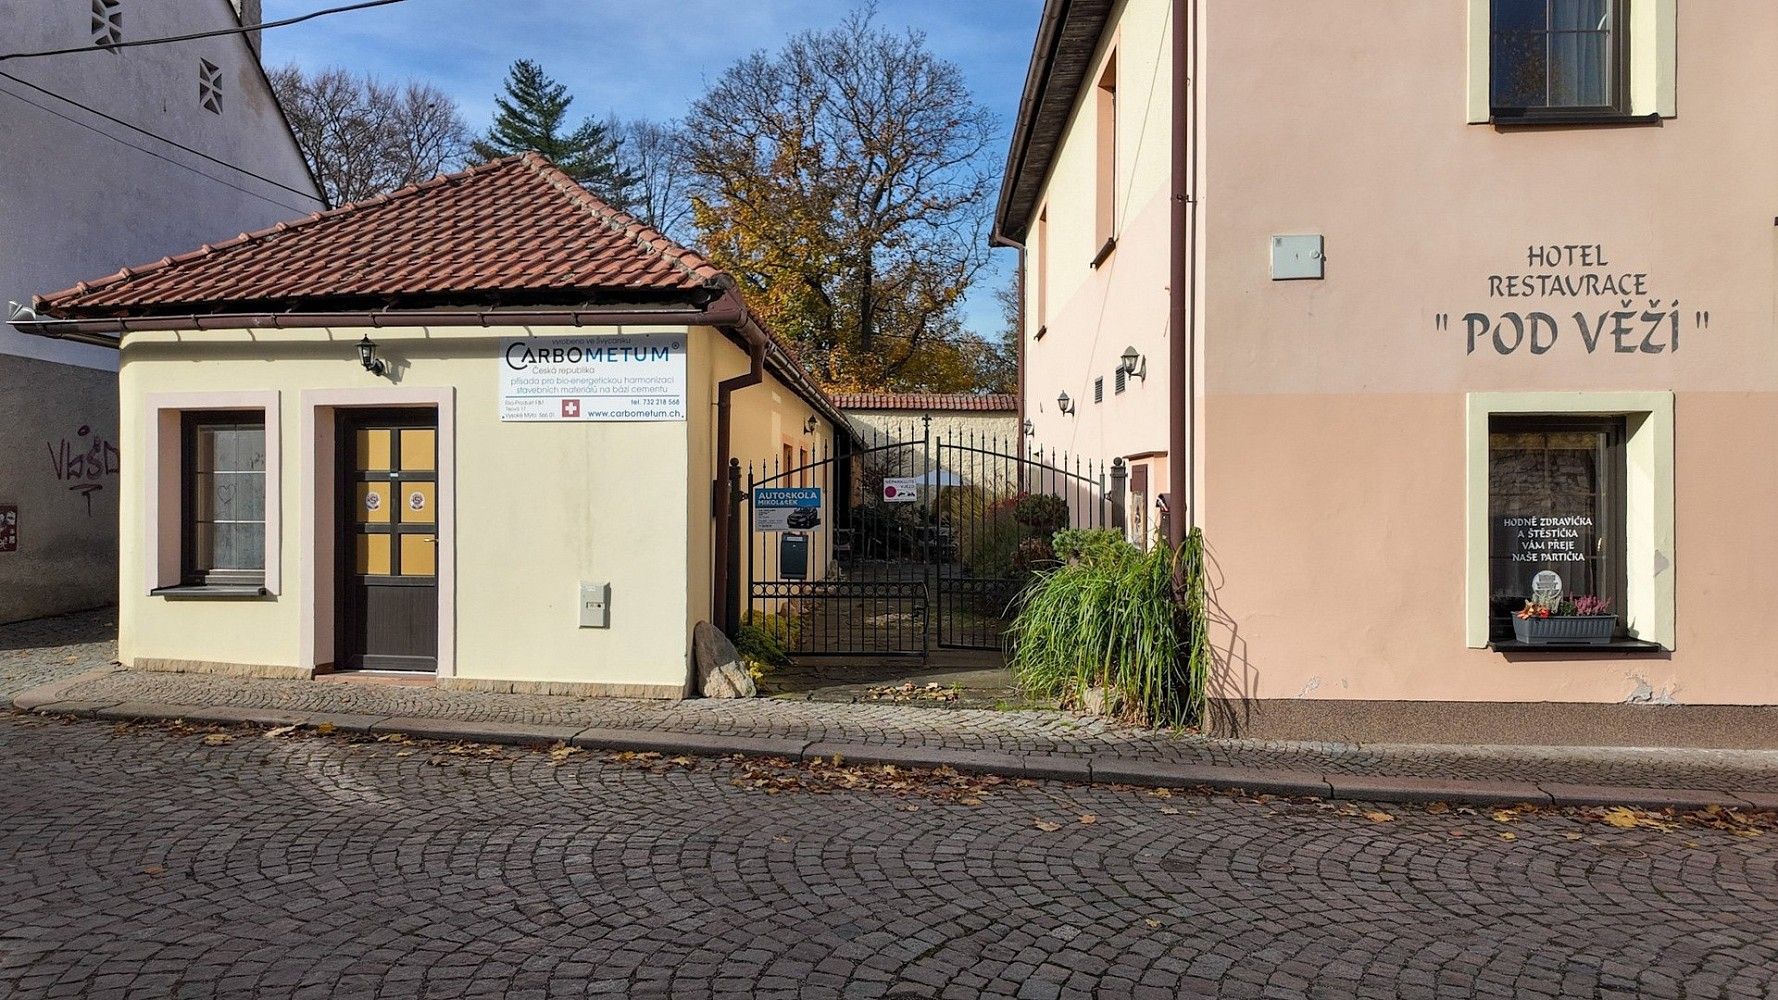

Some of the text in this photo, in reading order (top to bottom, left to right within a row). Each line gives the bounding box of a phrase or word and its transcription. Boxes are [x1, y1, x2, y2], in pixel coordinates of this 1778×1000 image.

[1527, 244, 1608, 268] HOTEL
[1461, 312, 1558, 356] POD
[1571, 299, 1680, 354] VĚŽÍ
[532, 365, 595, 376] Česká republika
[541, 378, 555, 387] pro
[631, 385, 668, 393] cementu
[588, 409, 681, 418] www.carbometum.ch
[1504, 515, 1593, 527] HODNĚ ZDRAVÍČKA
[1517, 527, 1579, 538] A ŠTĚSTÍČKA
[1522, 538, 1575, 550] VÁM PŘEJE
[1512, 551, 1585, 561] NAŠE PARTIČKA
